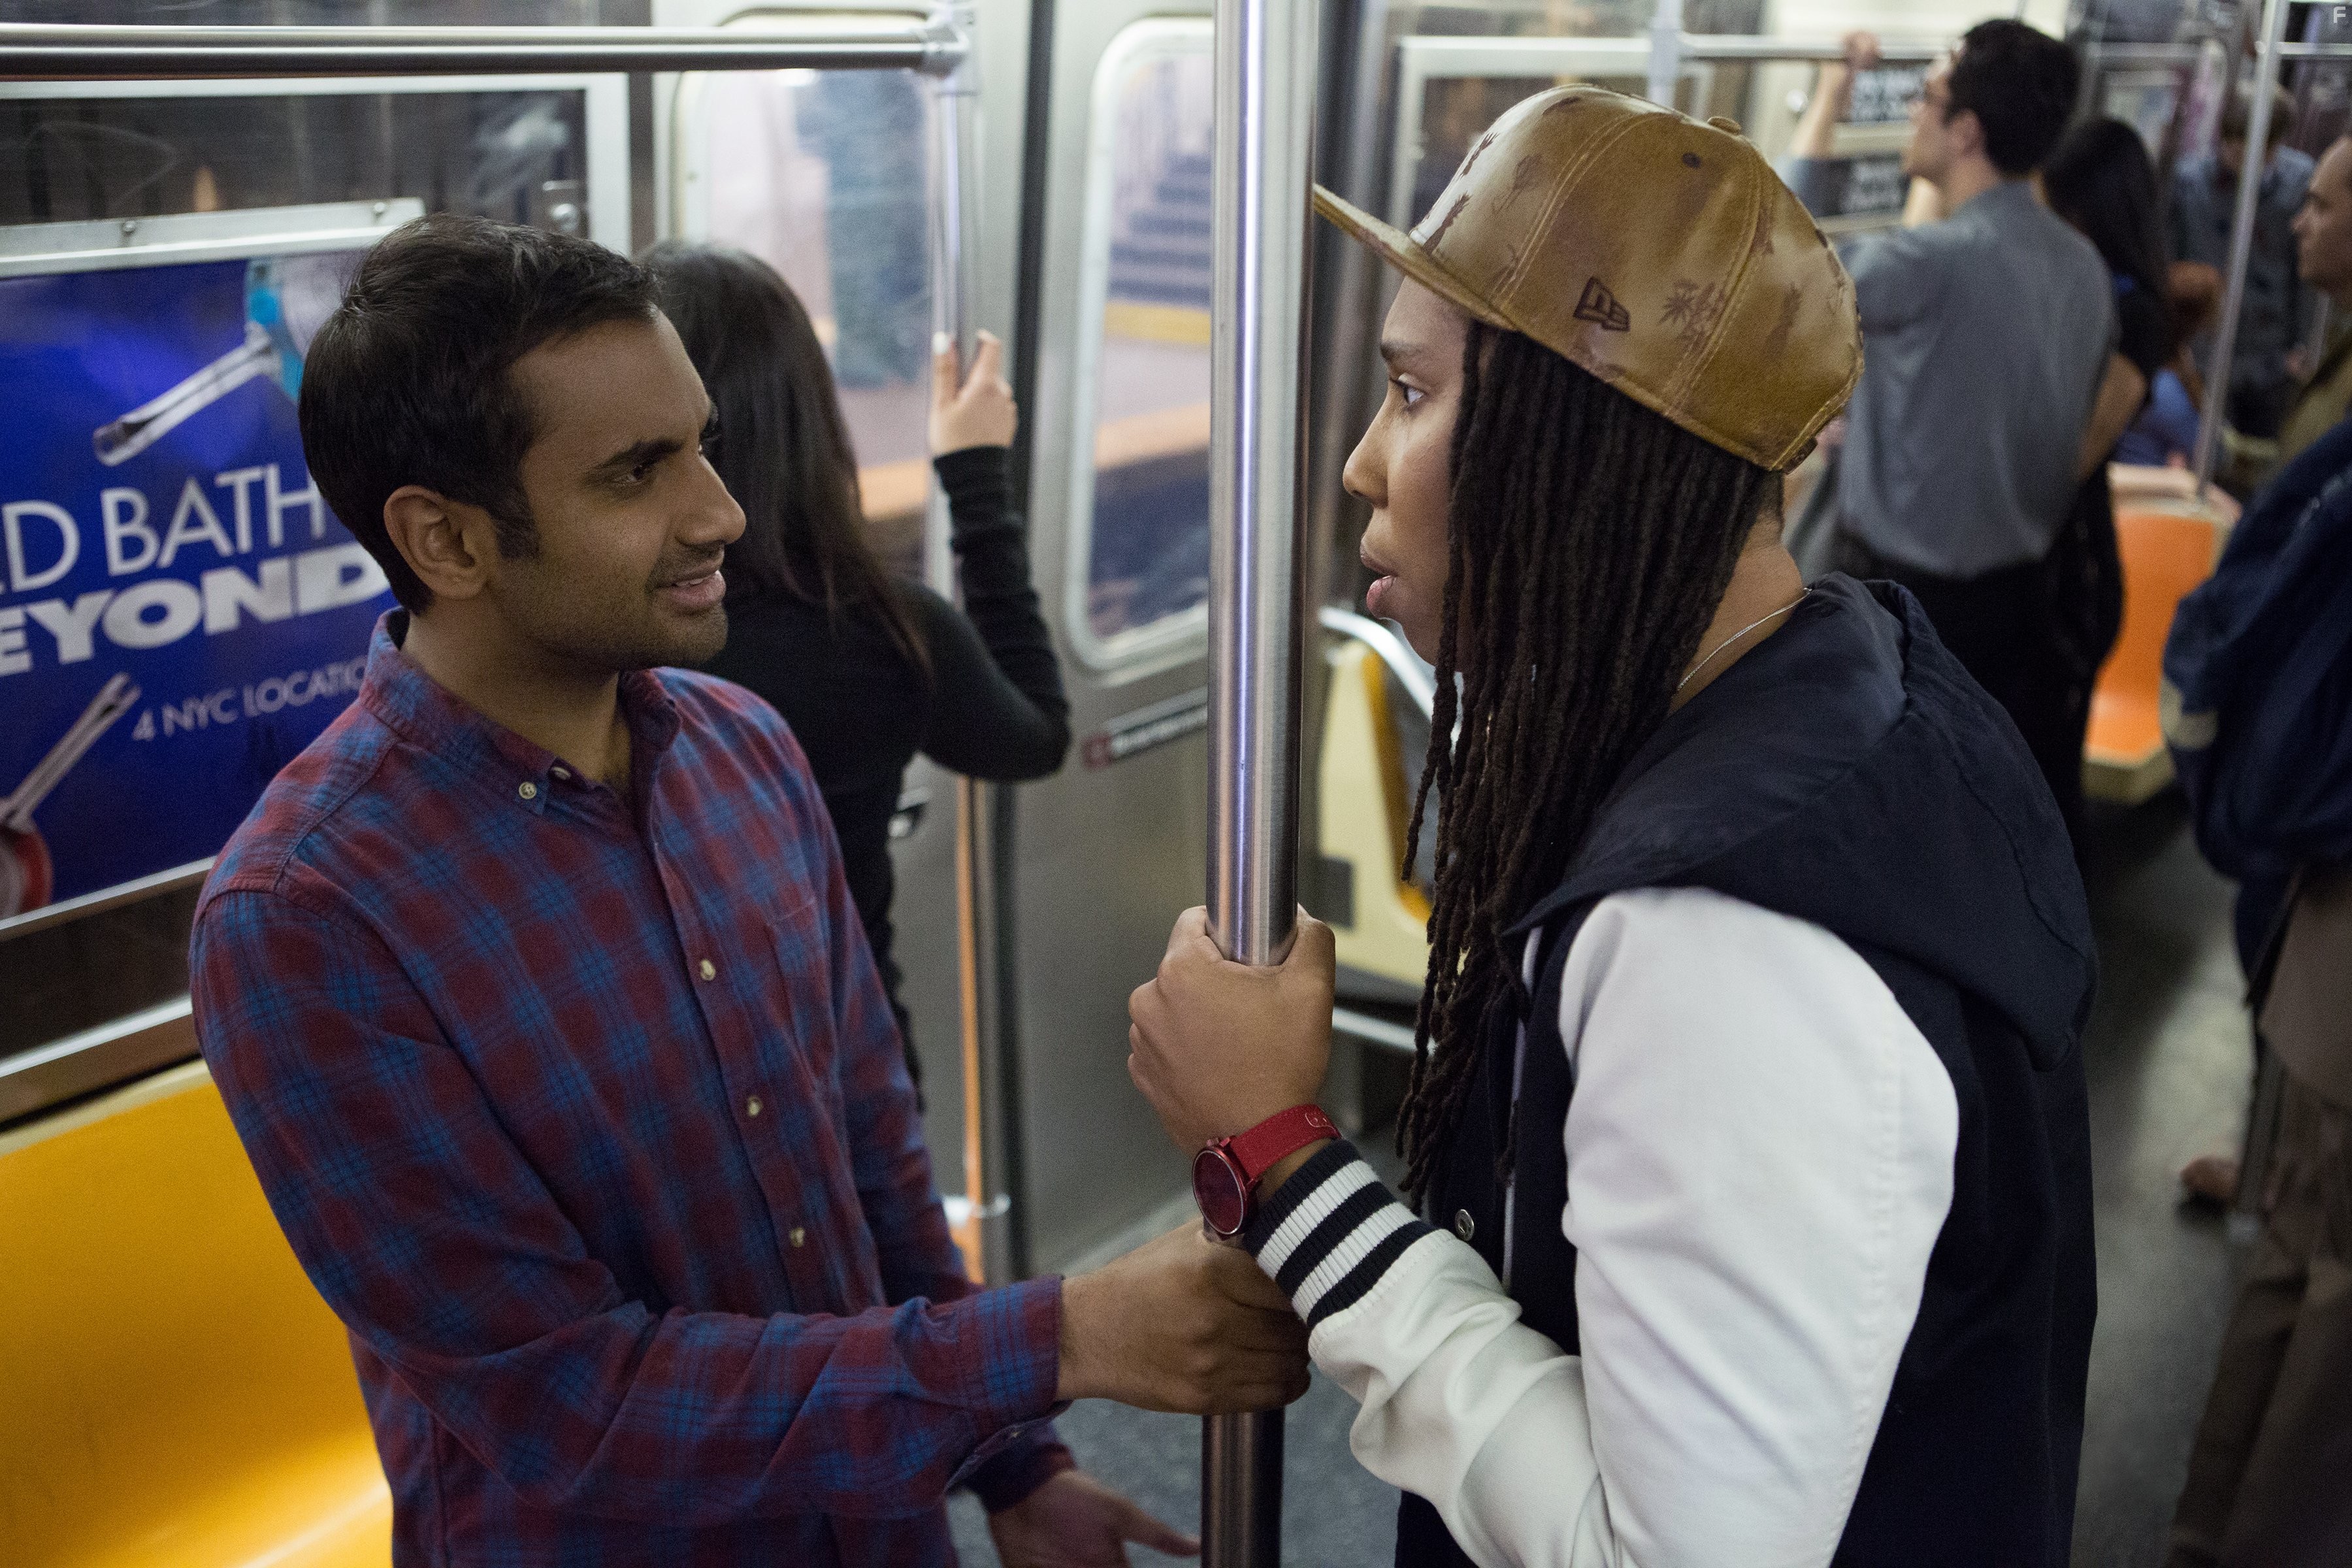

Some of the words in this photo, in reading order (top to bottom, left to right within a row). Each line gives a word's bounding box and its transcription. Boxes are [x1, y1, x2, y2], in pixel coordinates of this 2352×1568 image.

[0, 499, 80, 592] D
[101, 463, 325, 577] BATH
[131, 708, 156, 741] 4
[161, 688, 239, 737] NYC
